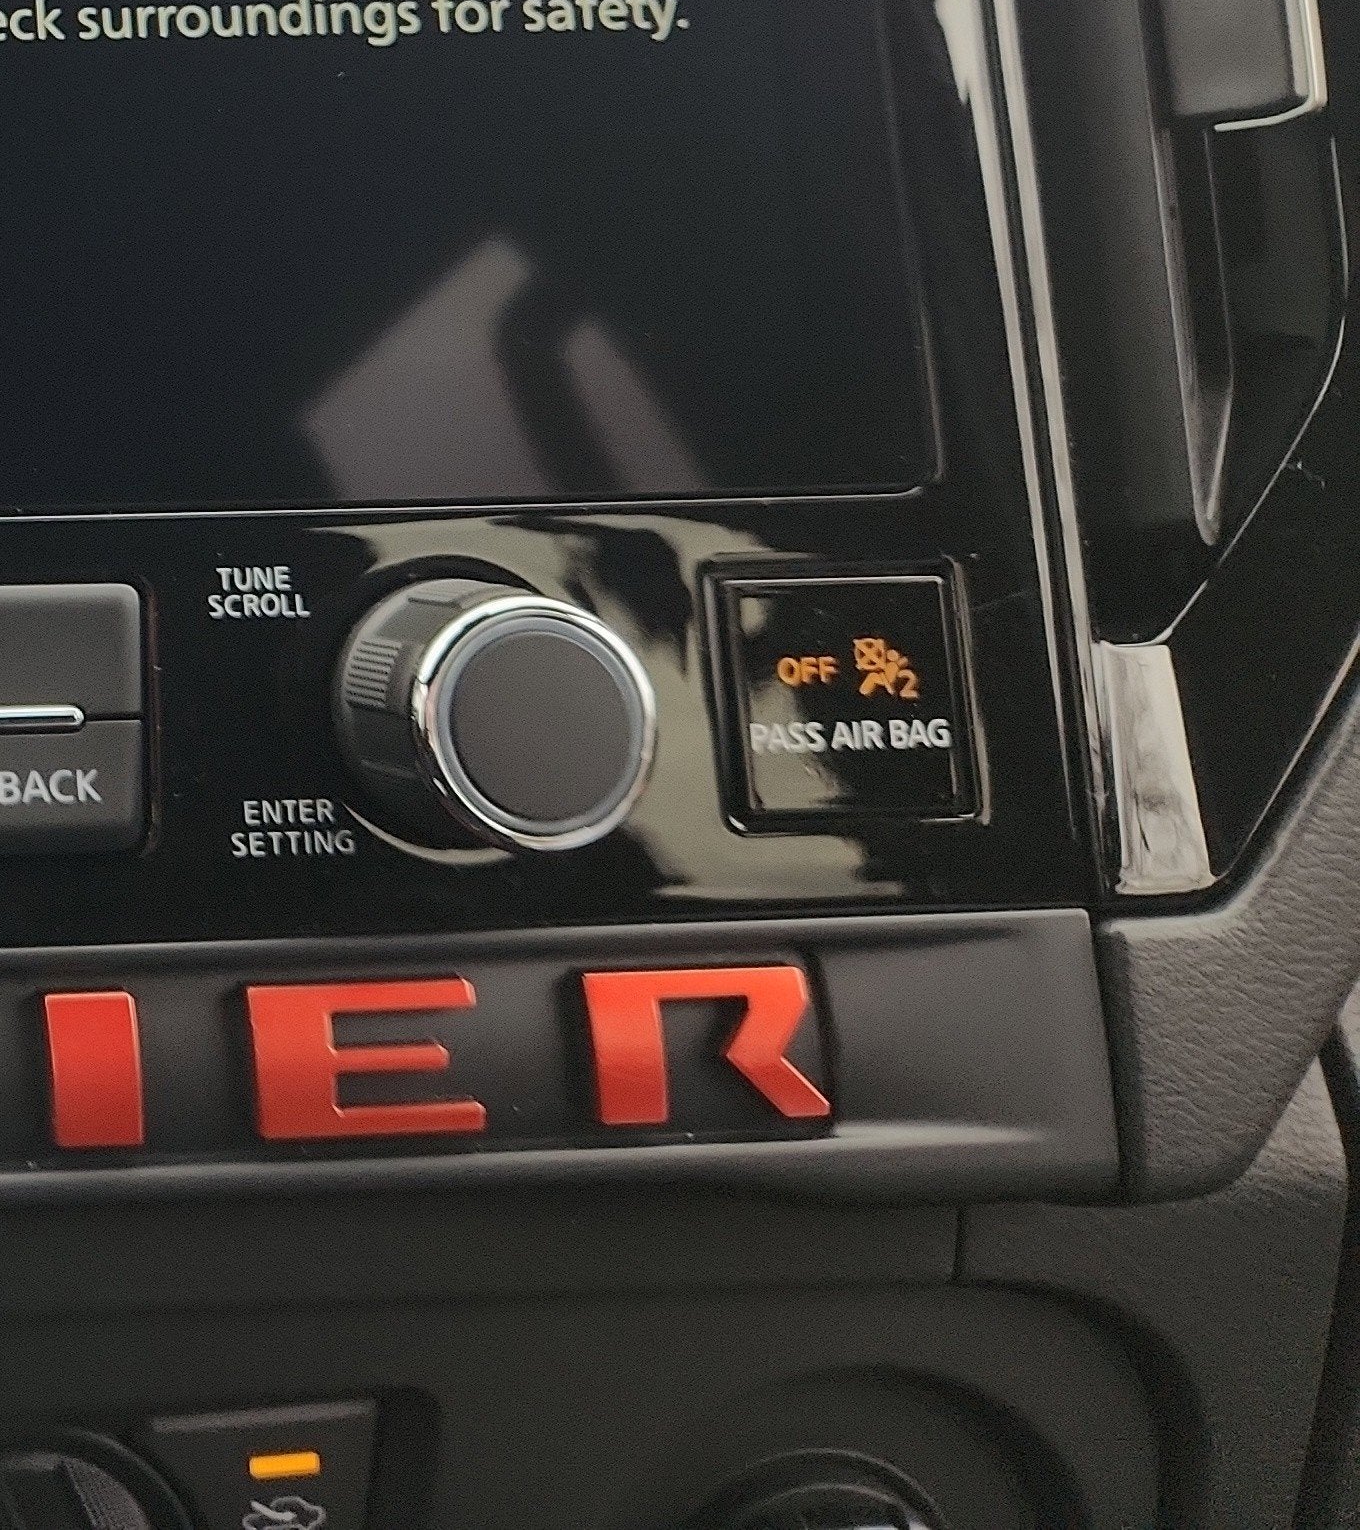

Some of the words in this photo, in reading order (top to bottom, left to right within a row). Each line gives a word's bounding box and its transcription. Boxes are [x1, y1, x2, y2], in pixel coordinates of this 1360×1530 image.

[215, 565, 293, 593] TUNE
[206, 591, 312, 619] SCROLL
[777, 657, 838, 687] OFF
[748, 721, 829, 754] PASS
[830, 719, 886, 751] AIR
[888, 717, 954, 750] BAG
[241, 797, 336, 826] ENTER
[230, 828, 356, 858] SETTING
